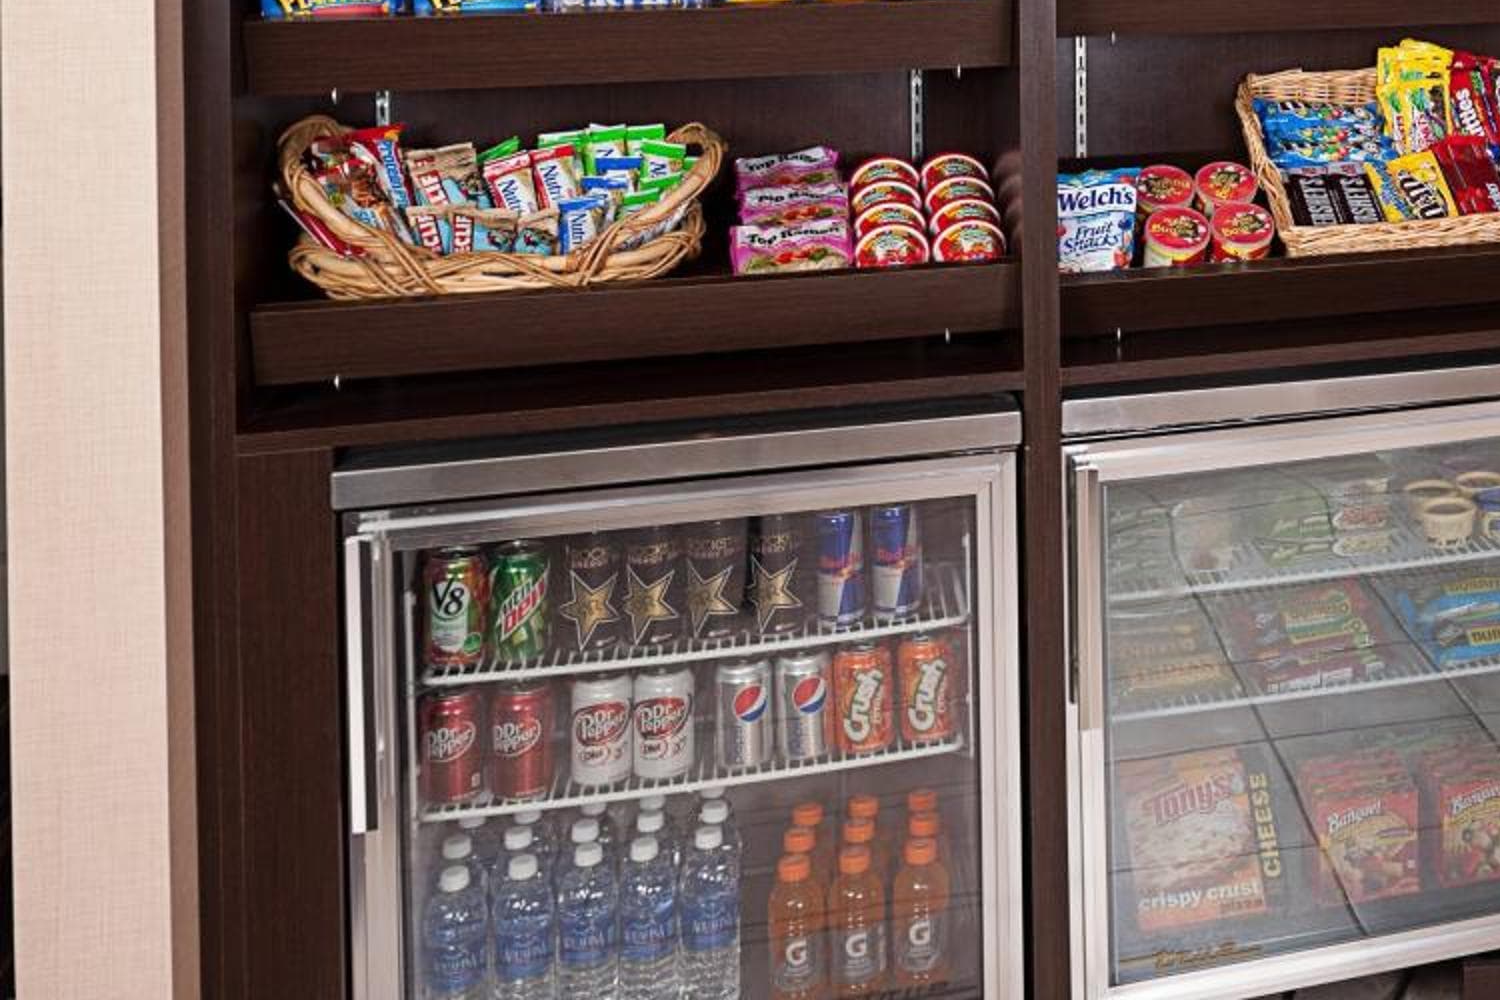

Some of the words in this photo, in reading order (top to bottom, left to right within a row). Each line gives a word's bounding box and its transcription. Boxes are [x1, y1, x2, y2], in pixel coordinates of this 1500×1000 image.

[419, 172, 448, 204] LIF
[1058, 187, 1135, 212] Welch's
[1300, 178, 1338, 226] ERSHEY'S
[1340, 178, 1379, 225] RSHEY'S
[572, 213, 586, 245] Nutri
[1063, 232, 1120, 255] Snacks
[1075, 220, 1114, 241] Fruit
[432, 578, 465, 616] V8
[1249, 772, 1281, 879] CHEESE
[1138, 889, 1202, 911] crispy
[1206, 879, 1259, 900] crust
[845, 931, 868, 958] G
[909, 919, 932, 946] G
[786, 938, 808, 966] G
